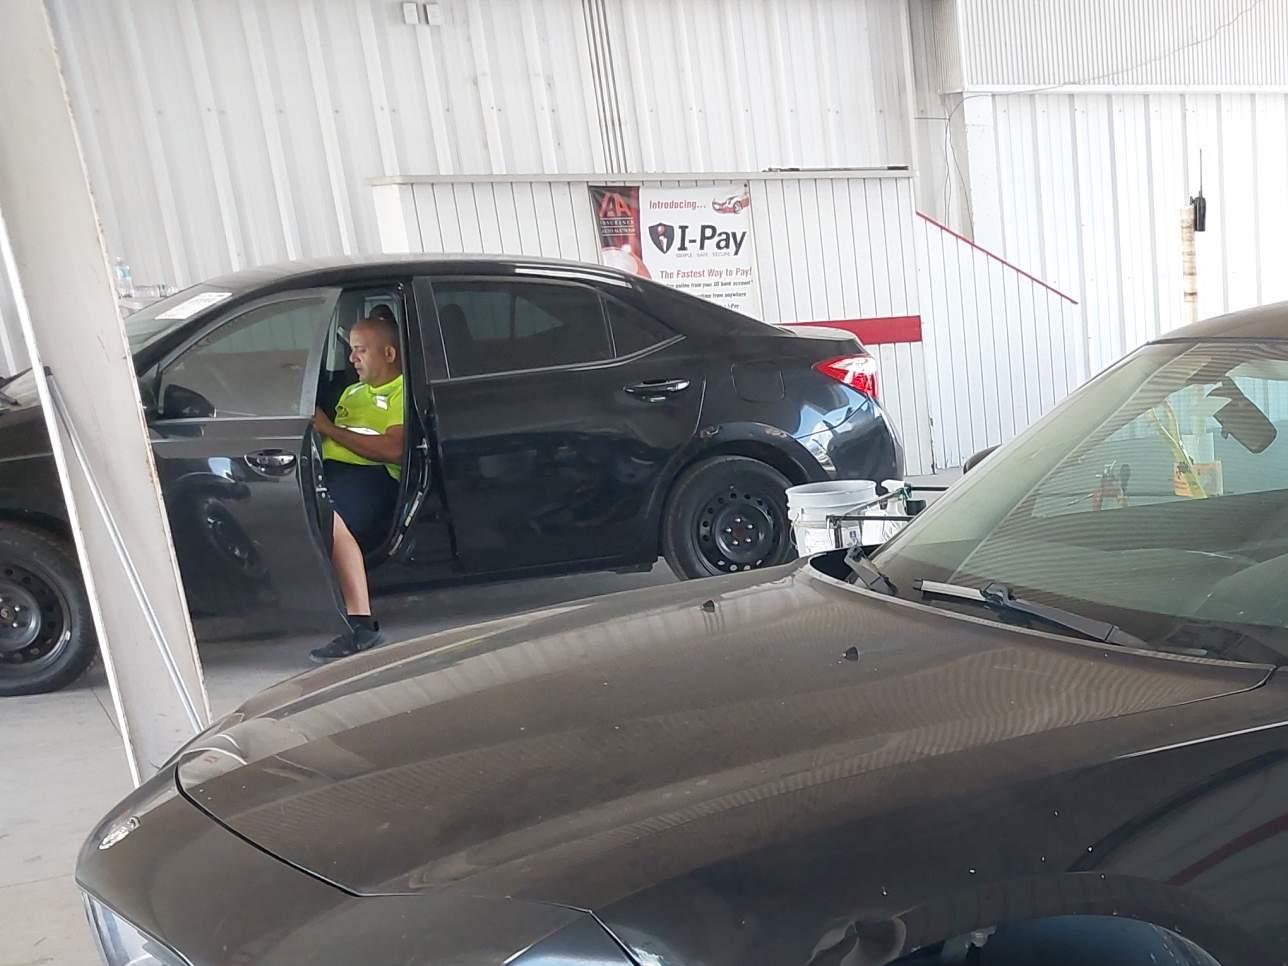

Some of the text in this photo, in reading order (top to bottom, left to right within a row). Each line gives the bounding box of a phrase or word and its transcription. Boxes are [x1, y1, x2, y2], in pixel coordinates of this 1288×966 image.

[649, 200, 706, 210] Introducing...
[677, 224, 747, 256] I-Pay
[660, 266, 753, 279] The Fastest Way to Pay!
